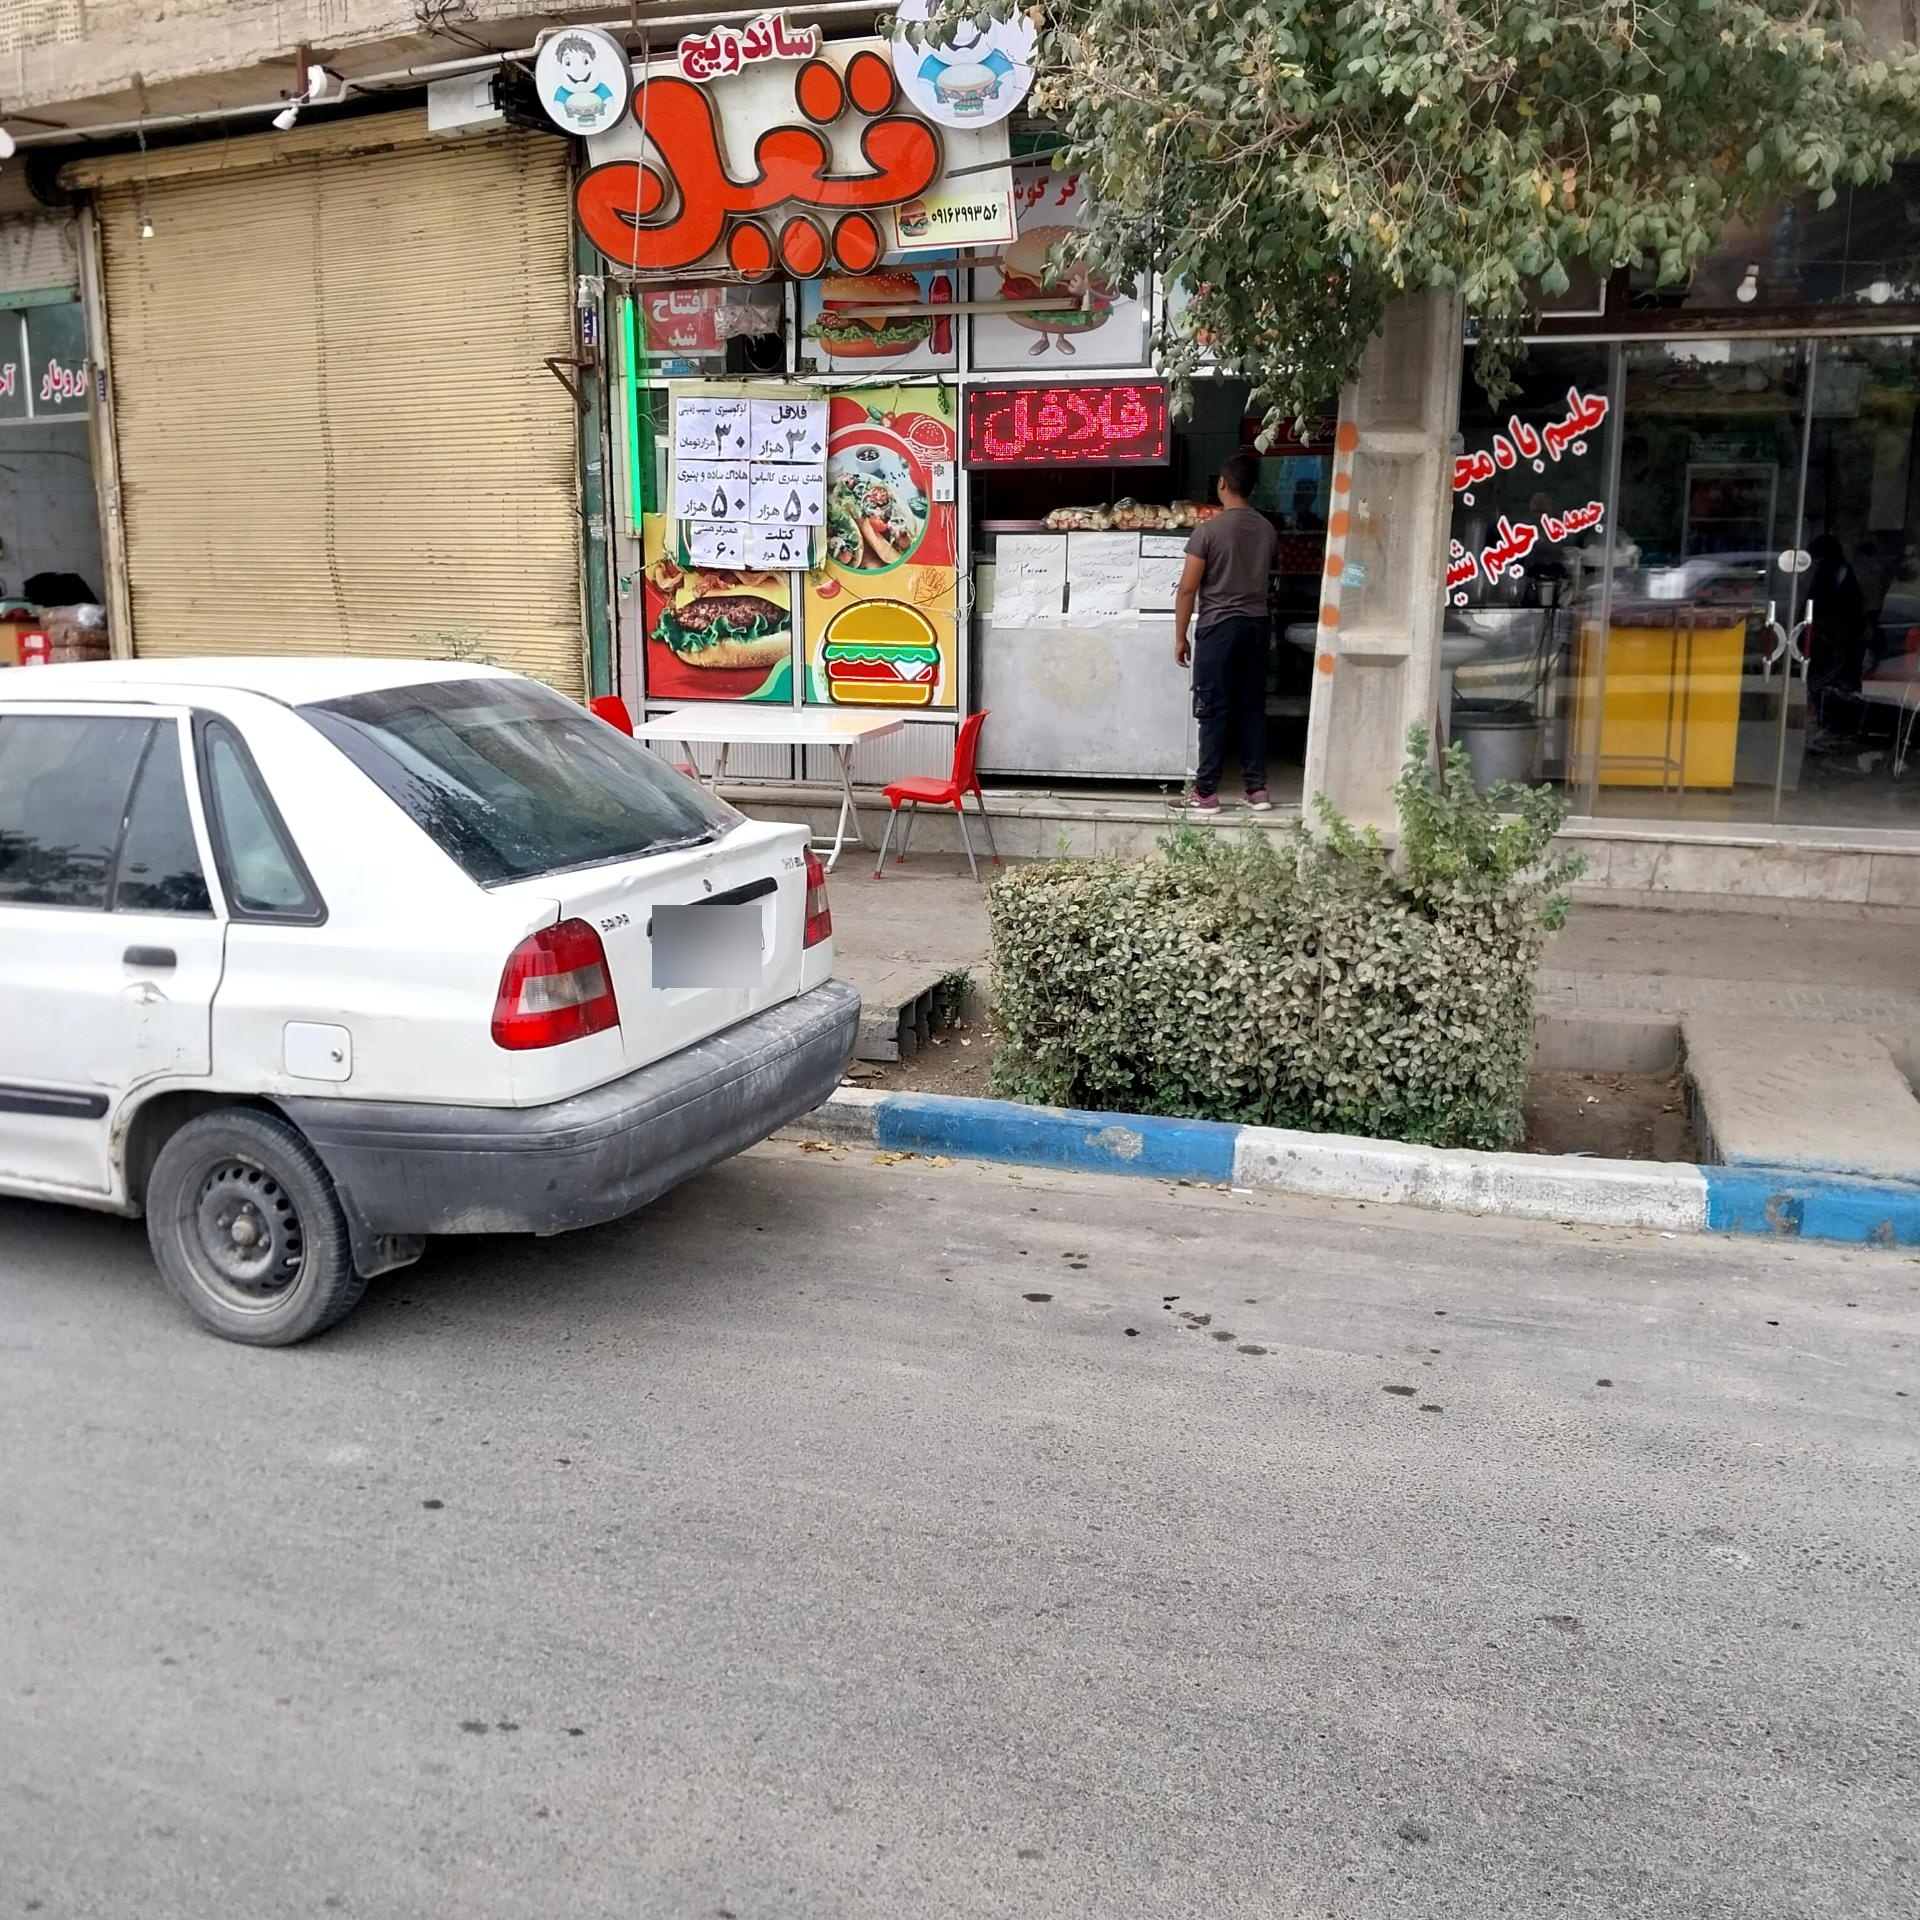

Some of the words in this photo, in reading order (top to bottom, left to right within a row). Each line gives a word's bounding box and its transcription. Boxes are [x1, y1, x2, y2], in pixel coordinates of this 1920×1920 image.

[681, 20, 813, 78] ساندویچ
[575, 50, 940, 280] تپل
[652, 289, 709, 322] افتتاح
[669, 323, 698, 346] شد
[771, 405, 807, 424] فلافل
[984, 388, 1148, 457] فلافل
[1542, 386, 1609, 462] حلیم
[715, 423, 746, 458] ۳۰
[758, 440, 784, 458] هزار
[786, 428, 822, 460] ۳۰
[677, 470, 699, 483] پنیری
[700, 471, 706, 483] و
[751, 471, 775, 485] کالباس
[778, 474, 800, 485] بندری
[683, 500, 708, 516] هزار
[711, 485, 746, 519] ۵۰
[757, 504, 780, 520] هزار
[784, 488, 820, 523] ۵۰
[765, 528, 795, 540] کتلت
[715, 541, 736, 560] ۶۰
[779, 542, 801, 561] ۵۰
[1481, 515, 1538, 584] حلیم
